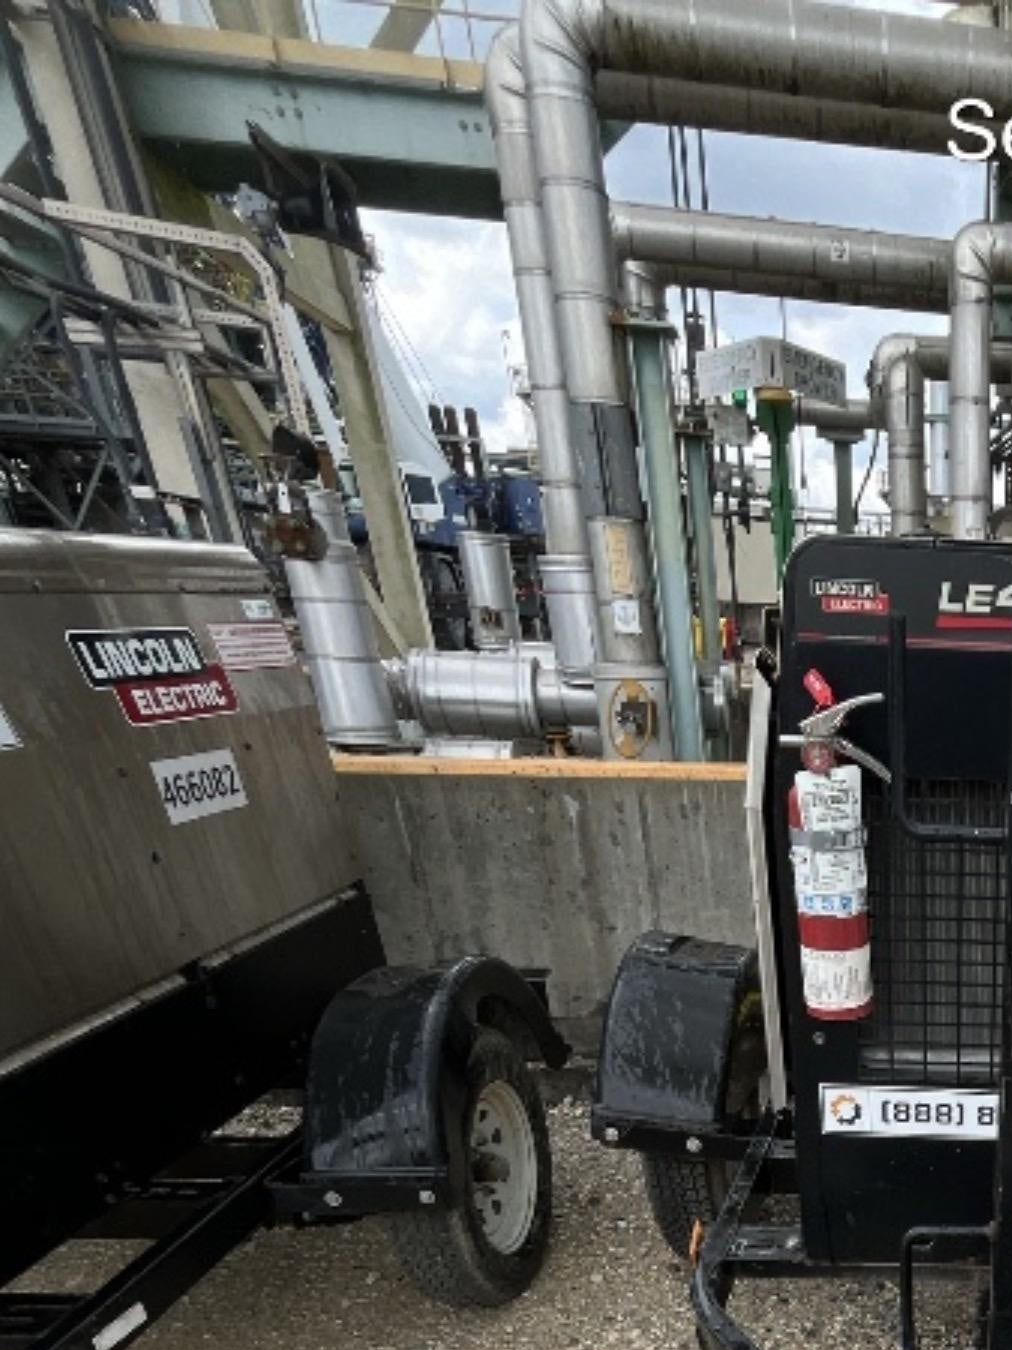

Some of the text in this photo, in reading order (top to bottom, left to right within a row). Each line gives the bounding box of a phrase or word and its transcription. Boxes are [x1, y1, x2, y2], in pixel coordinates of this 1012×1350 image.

[77, 637, 202, 679] LINCOLN
[130, 680, 228, 716] ELECTRIC
[162, 764, 241, 808] 466082
